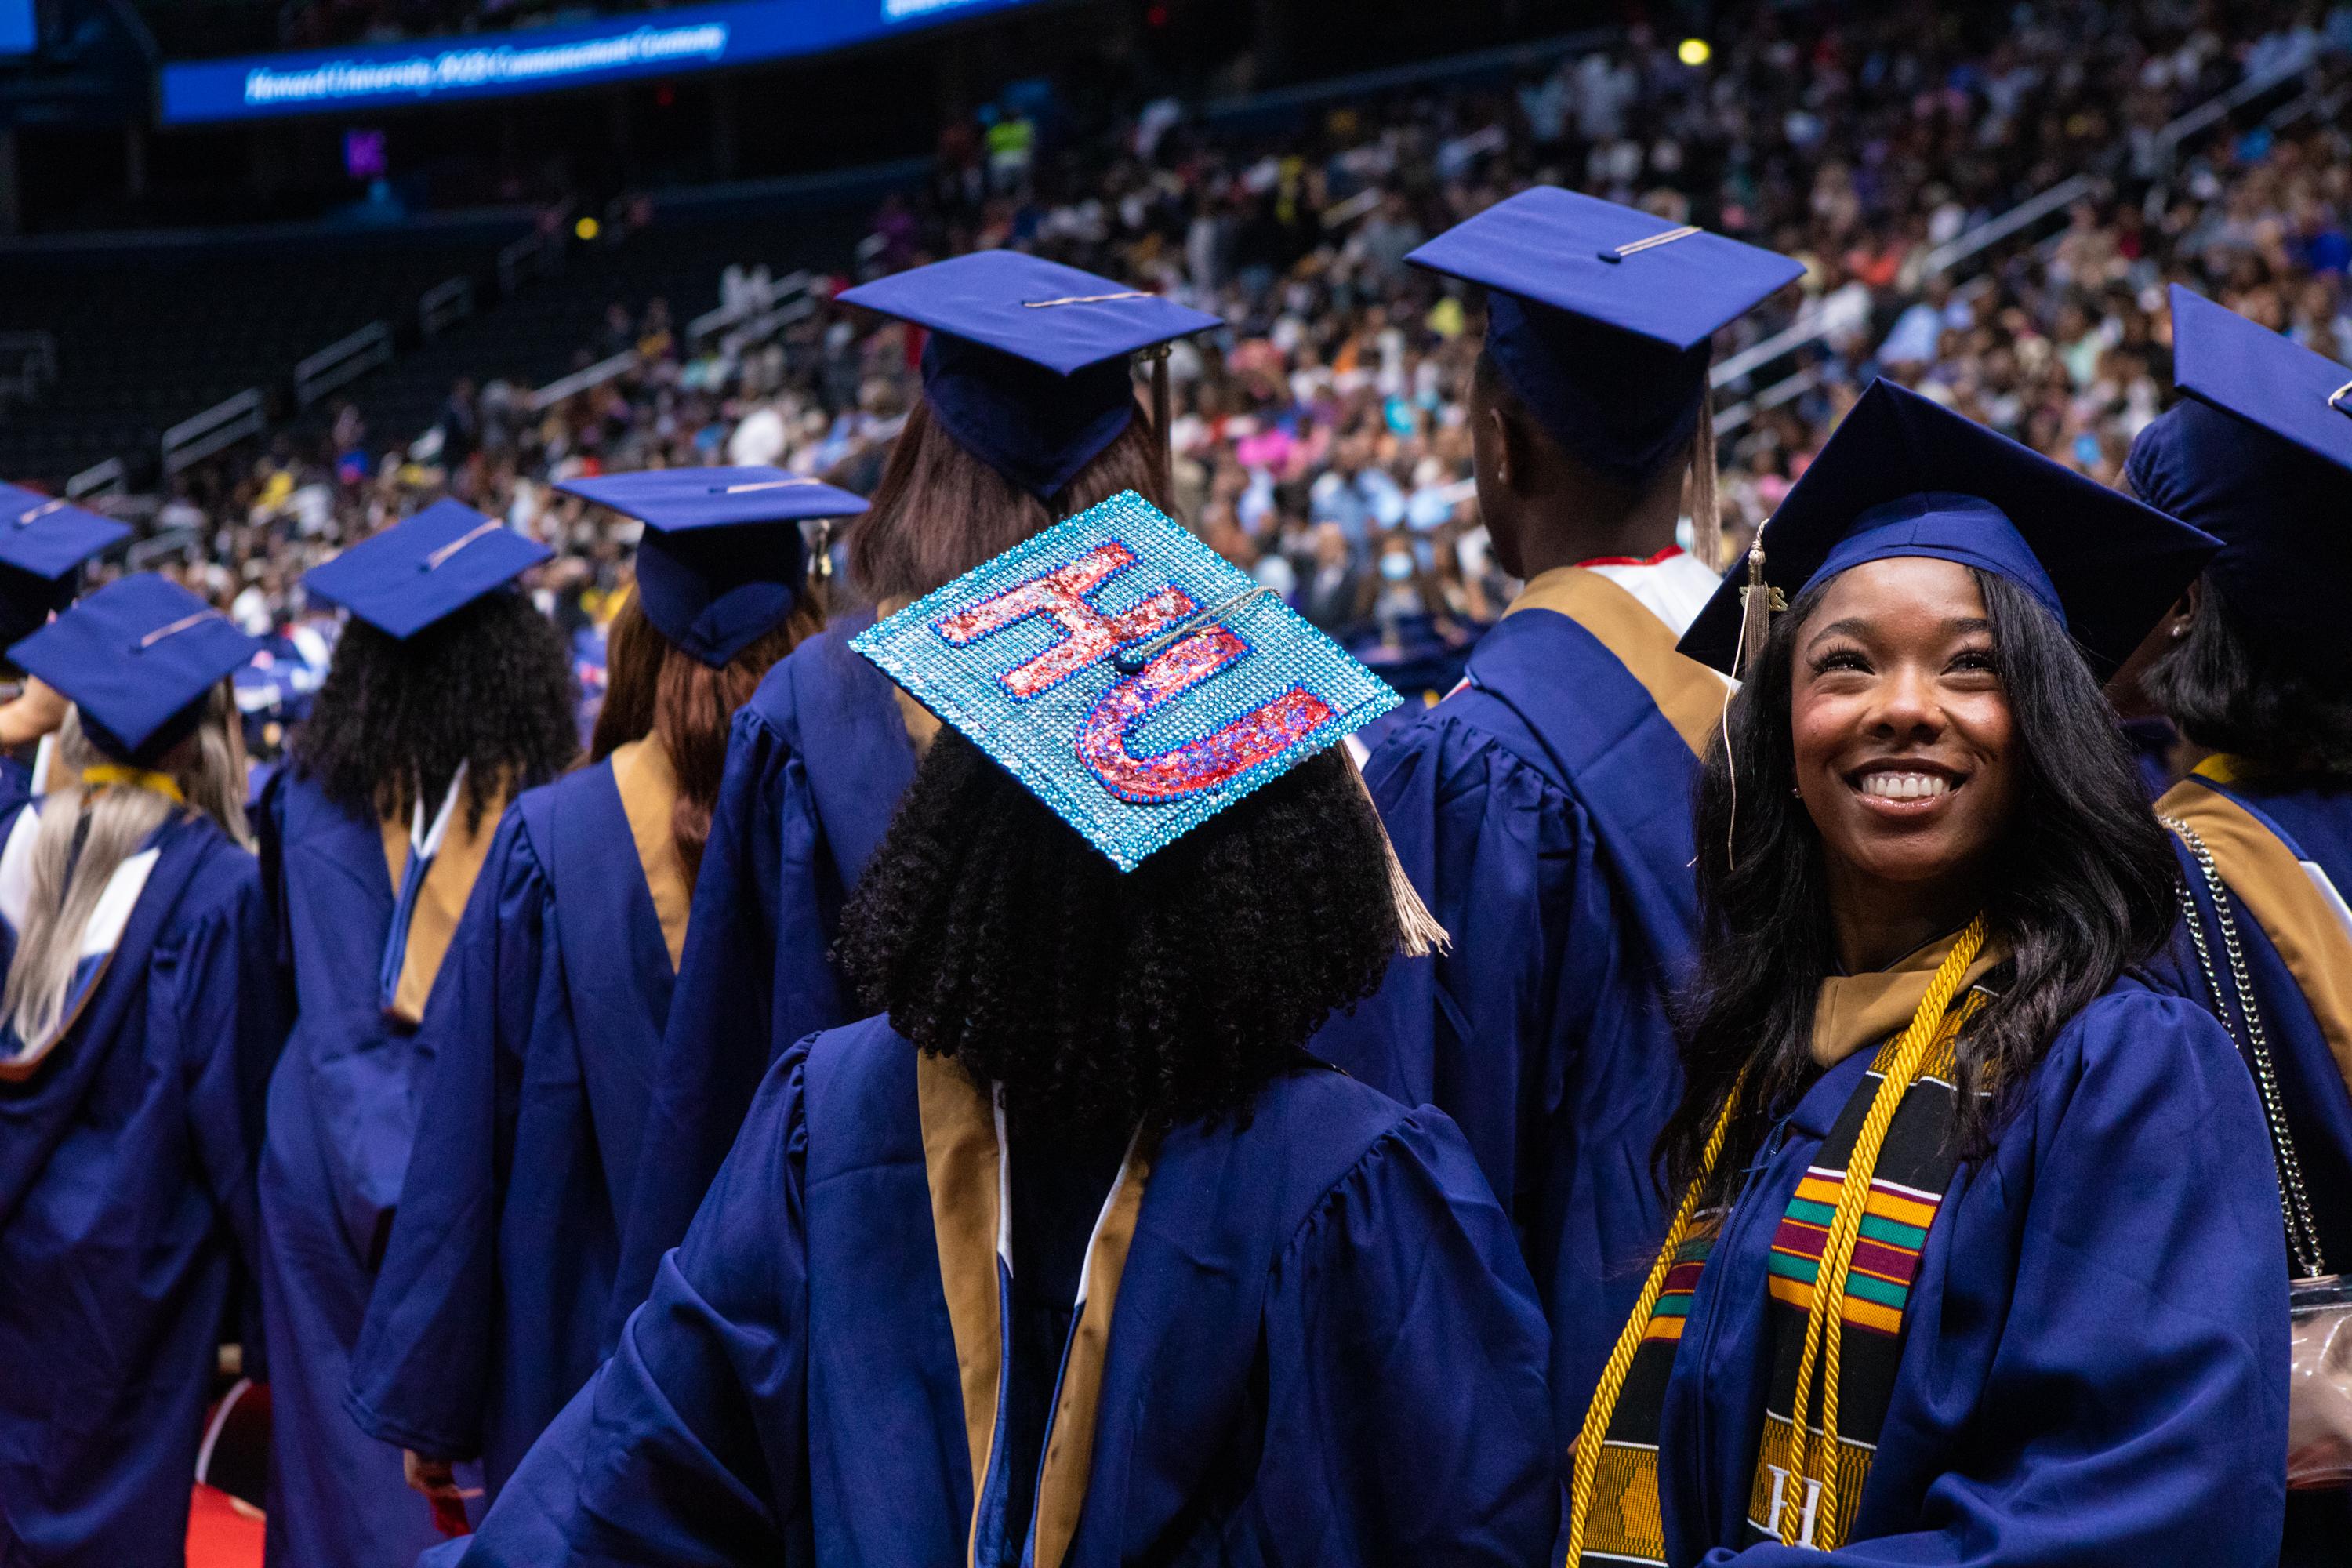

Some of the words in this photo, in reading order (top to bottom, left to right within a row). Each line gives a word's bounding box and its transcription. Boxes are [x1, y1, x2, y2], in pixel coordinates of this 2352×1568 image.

[246, 64, 328, 103] Howard
[327, 59, 435, 97] University
[491, 34, 637, 82] Commencement
[632, 24, 728, 62] Ceremony
[1765, 1463, 1824, 1552] H
